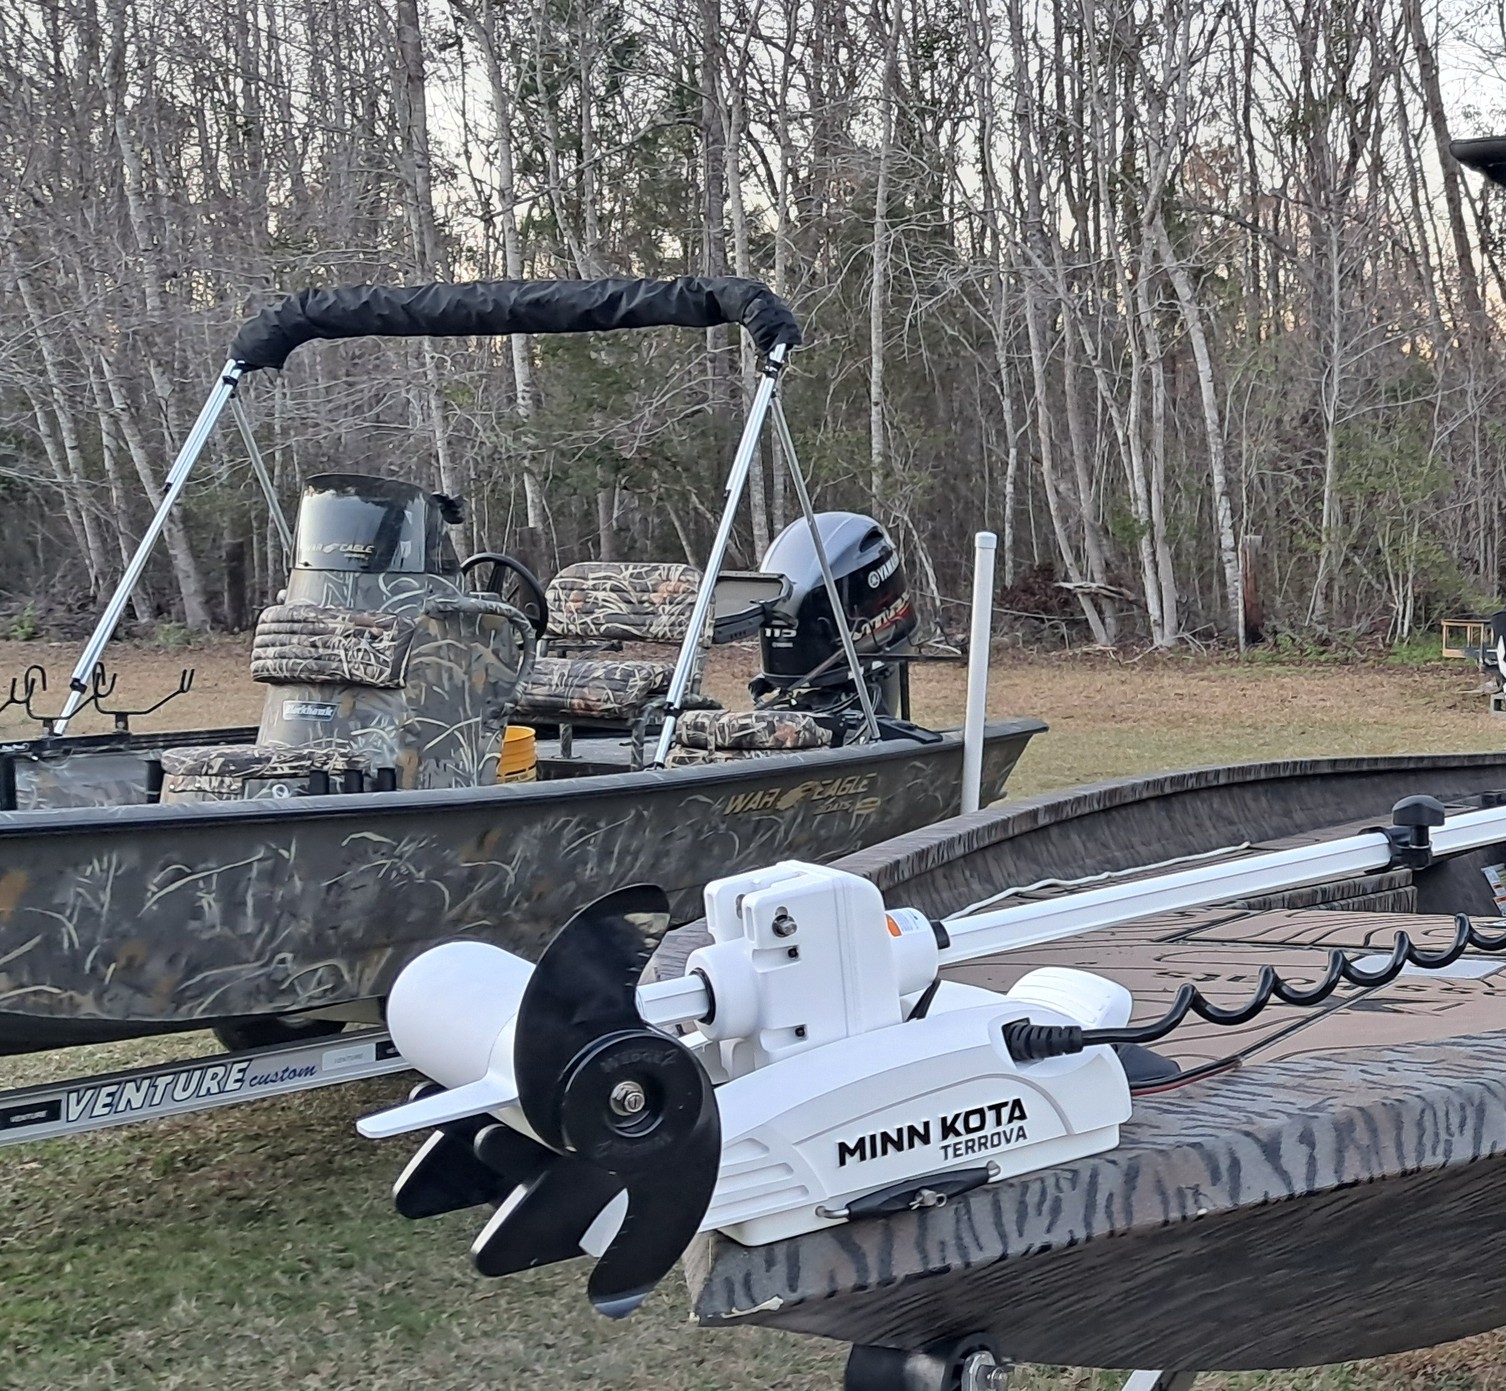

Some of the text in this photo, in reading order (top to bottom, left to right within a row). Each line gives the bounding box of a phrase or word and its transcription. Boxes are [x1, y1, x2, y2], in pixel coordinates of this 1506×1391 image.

[339, 544, 375, 554] EAGLE
[764, 627, 798, 639] 115
[724, 772, 878, 816] WAR EAGLE
[65, 1058, 318, 1123] VENTURE custom
[838, 1097, 1028, 1168] MINN KOTA
[939, 1125, 1028, 1161] TERROVA
